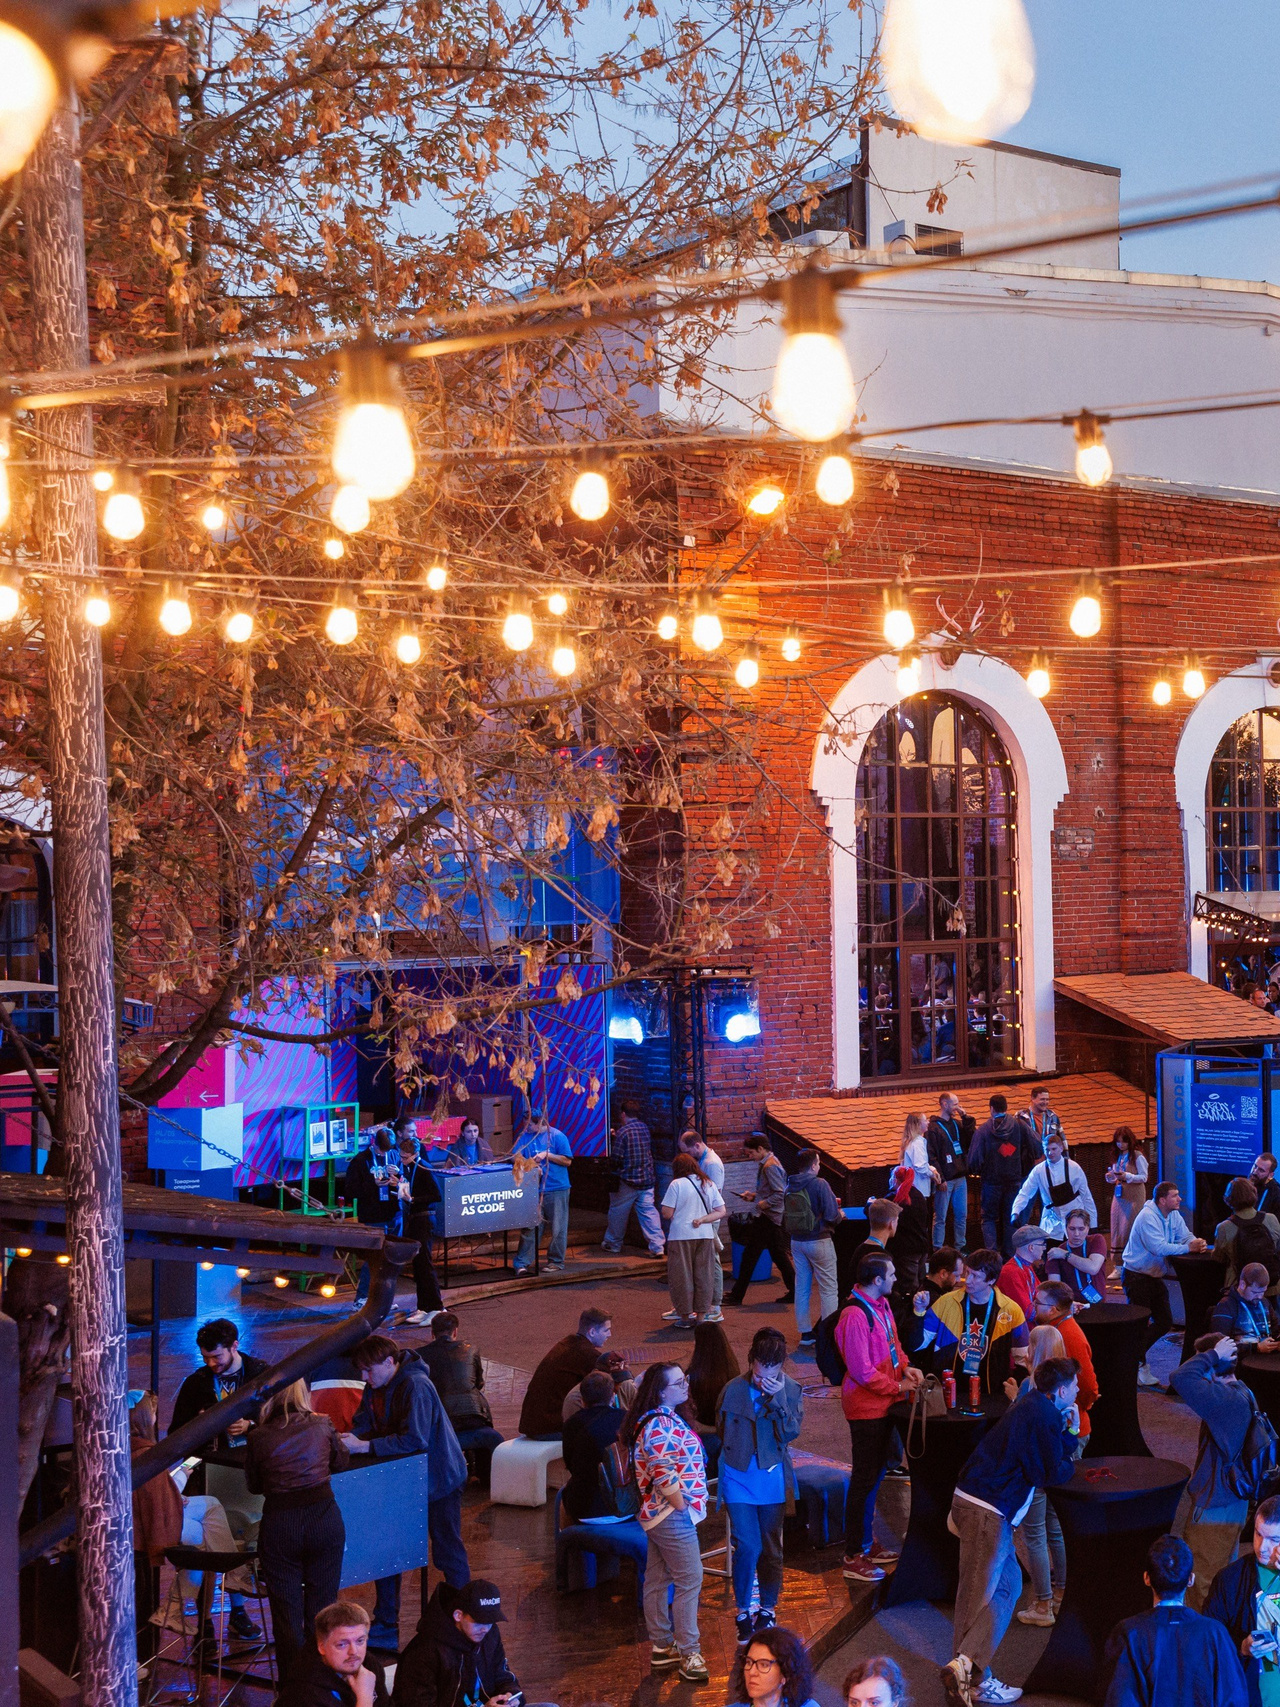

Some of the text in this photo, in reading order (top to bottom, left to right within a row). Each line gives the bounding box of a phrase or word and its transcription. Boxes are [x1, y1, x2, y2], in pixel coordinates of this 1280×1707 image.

[461, 1189, 524, 1205] EVERYTHING
[461, 1202, 505, 1216] AS CODE
